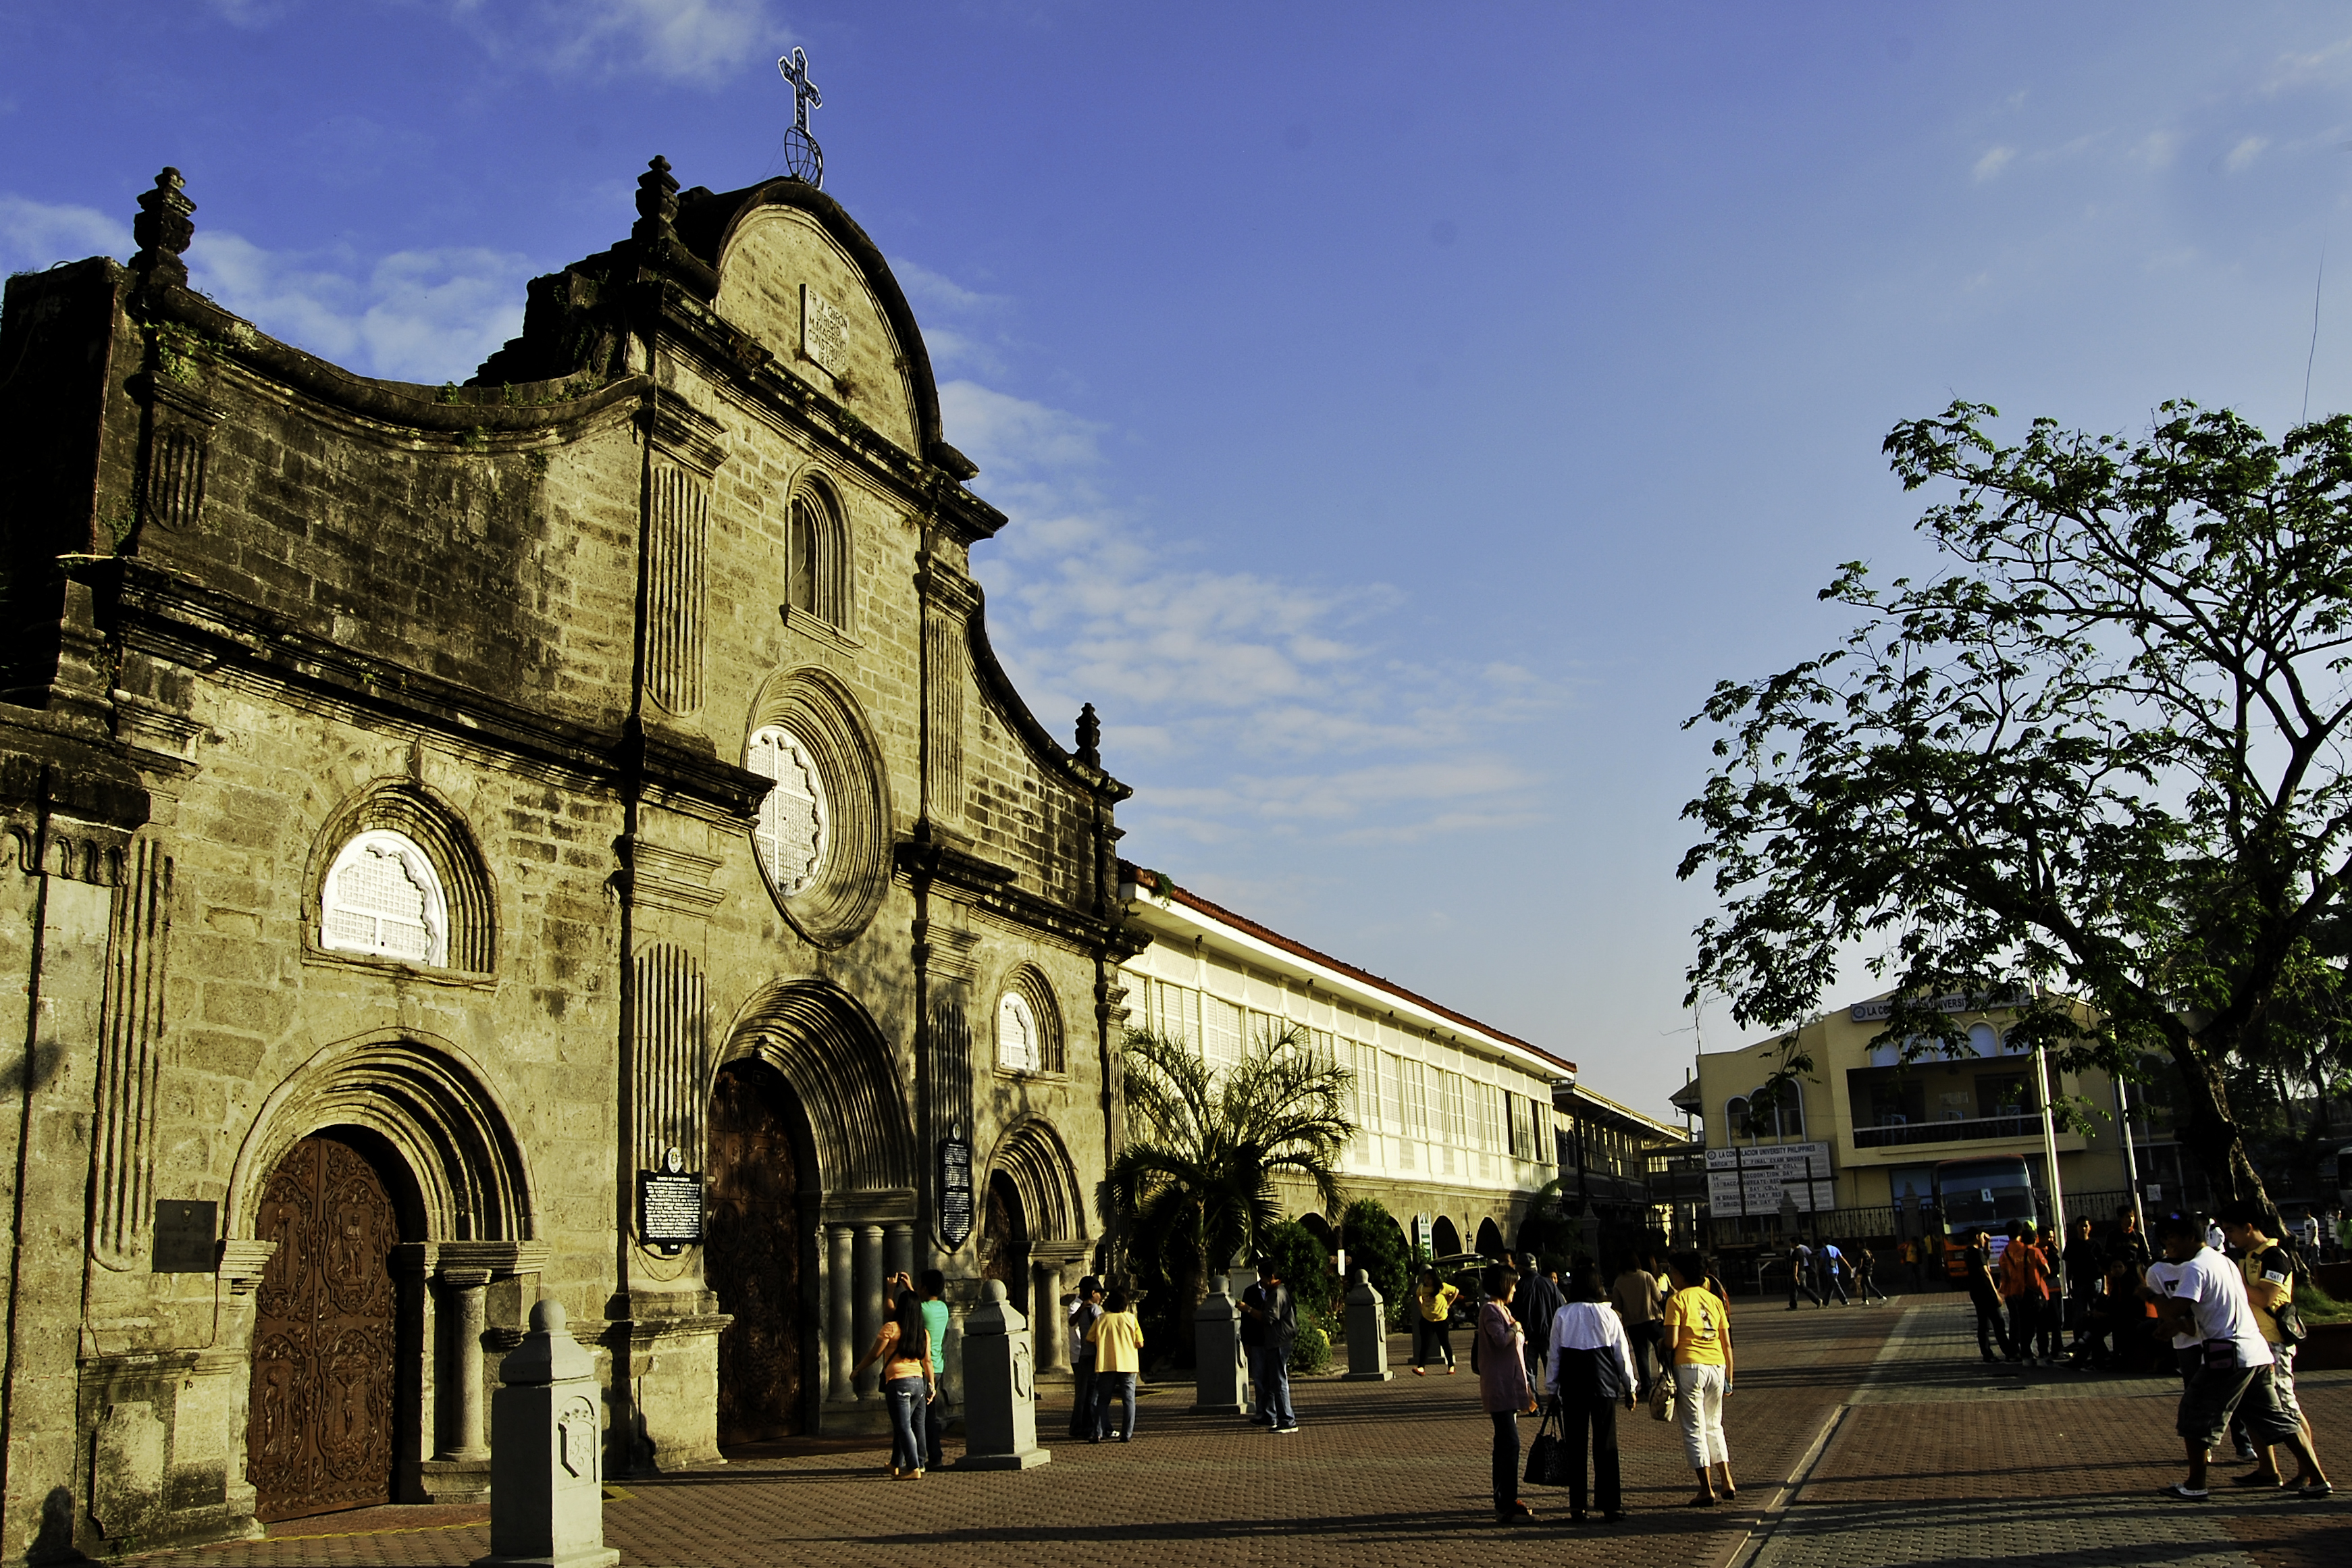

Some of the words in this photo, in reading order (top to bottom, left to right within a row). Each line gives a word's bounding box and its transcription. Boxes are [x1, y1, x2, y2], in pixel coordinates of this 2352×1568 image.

[1866, 1007, 1877, 1016] LA
[1726, 1149, 1758, 1157] CONLACION
[1759, 1147, 1785, 1155] UNIVERSITY
[1787, 1145, 1815, 1153] PHILIPPINES
[1984, 1191, 1989, 1199] 1
